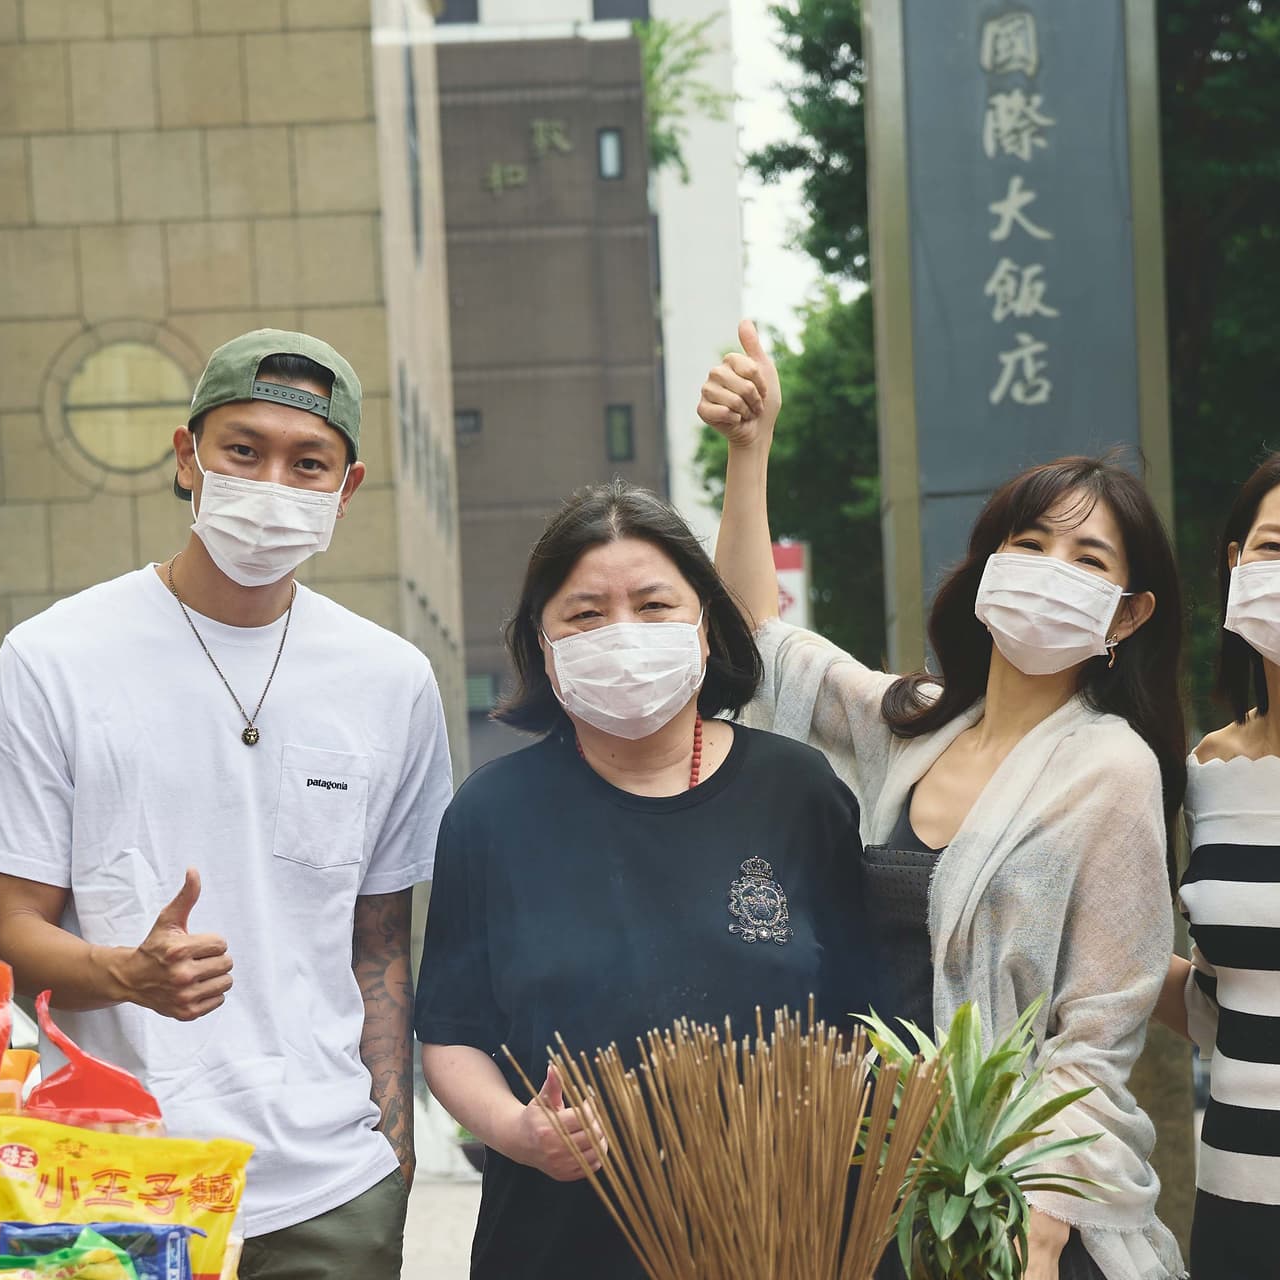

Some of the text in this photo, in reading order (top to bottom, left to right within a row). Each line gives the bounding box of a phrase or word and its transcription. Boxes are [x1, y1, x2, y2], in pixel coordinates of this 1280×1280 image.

[981, 11, 1060, 405] 國際大飯店
[306, 778, 348, 790] patagonia
[35, 1166, 236, 1214] 小王子麵
